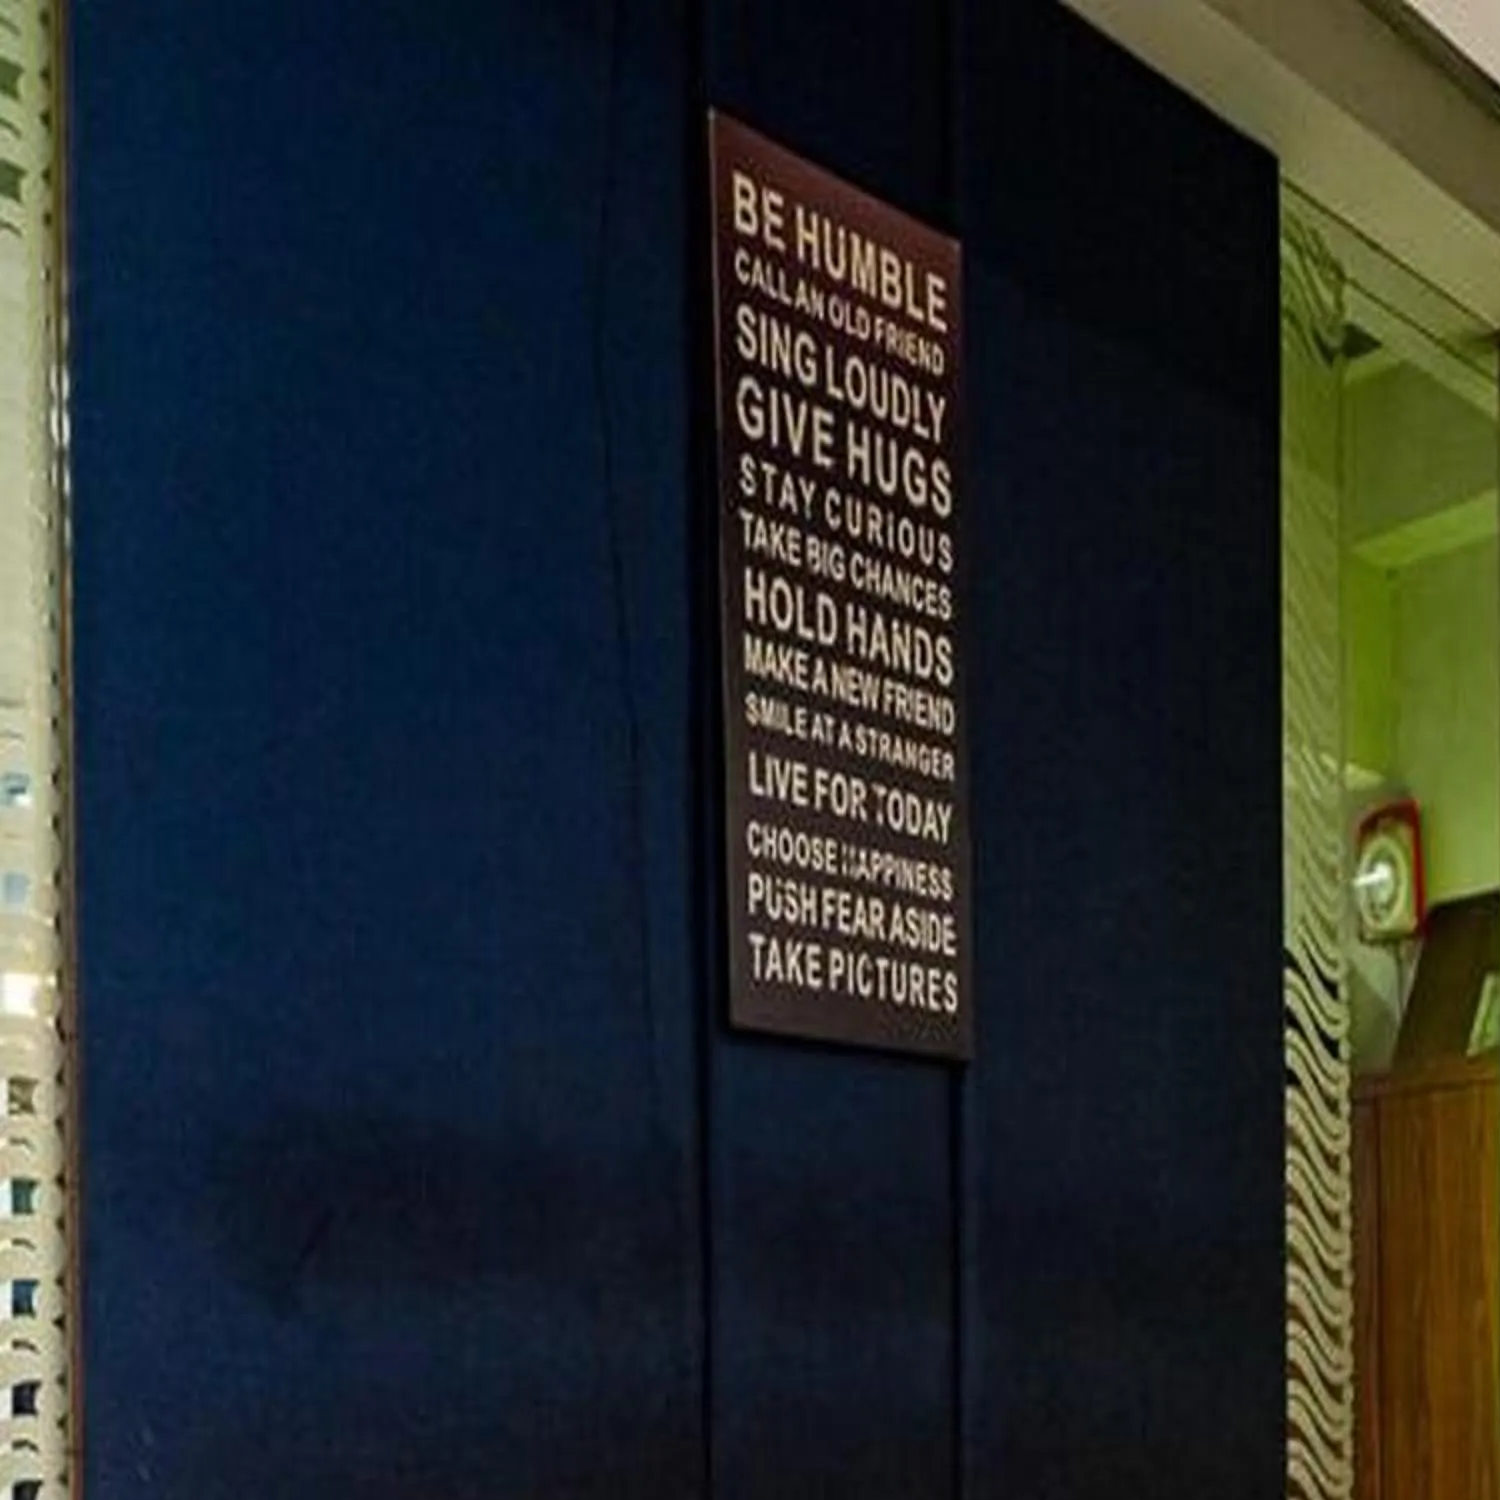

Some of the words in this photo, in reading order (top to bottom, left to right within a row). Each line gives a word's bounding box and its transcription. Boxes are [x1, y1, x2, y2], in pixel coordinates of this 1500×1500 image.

[732, 170, 786, 250] BE
[796, 205, 947, 334] HUMBLE
[735, 247, 791, 306] CALL
[795, 278, 825, 320] AN
[828, 295, 870, 340] OLD
[874, 316, 945, 376] FRIEND
[736, 303, 817, 386] SING
[825, 345, 945, 443] LOUDLY
[736, 376, 835, 468] GIVE
[848, 420, 951, 517] HUGS
[740, 453, 816, 518] STAY
[824, 488, 952, 573] CURIOUS
[740, 507, 801, 567] TAKE
[806, 536, 845, 581] BIG
[850, 552, 950, 622] CHANCES
[744, 567, 838, 646] HOLD
[847, 602, 953, 686] HANDS
[744, 633, 809, 690] MAKE
[812, 657, 828, 695] A
[831, 662, 880, 710] NEW
[883, 678, 955, 735] FRIEND
[745, 692, 807, 740] SMILE
[811, 713, 835, 745] AT
[838, 721, 852, 750] A
[855, 723, 955, 781] STRANGER
[747, 822, 838, 875] CHOOSE
[749, 751, 809, 807] LIVE
[814, 768, 868, 823] FOR
[872, 784, 952, 845] TODAY
[748, 872, 817, 926] PUSH
[821, 887, 886, 942] FEAR
[888, 902, 957, 956] ASIDE
[748, 932, 823, 989] TAKE
[828, 949, 958, 1013] PICTURES
